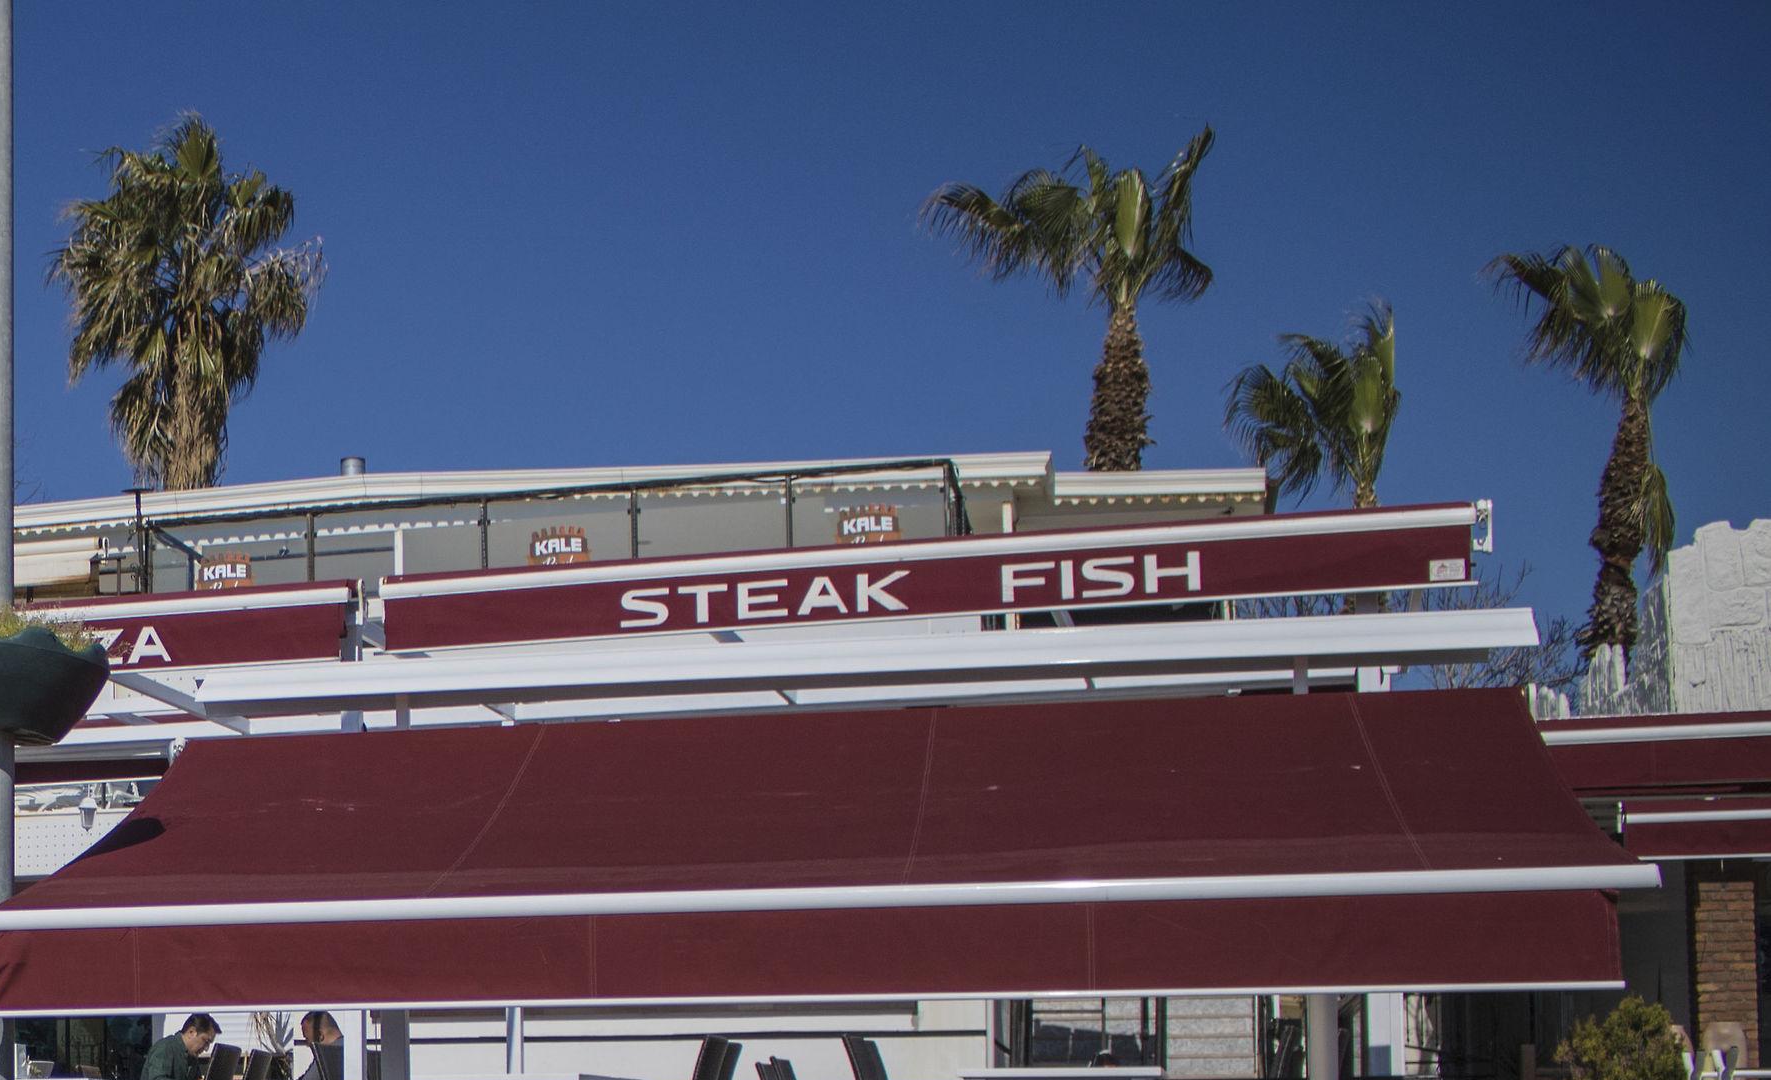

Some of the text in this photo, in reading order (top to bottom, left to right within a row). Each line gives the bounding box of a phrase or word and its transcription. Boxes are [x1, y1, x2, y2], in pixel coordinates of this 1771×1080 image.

[842, 515, 893, 536] KALE
[534, 537, 583, 556] KALE
[203, 563, 247, 582] KALE
[619, 550, 1203, 629] STEAK FISH
